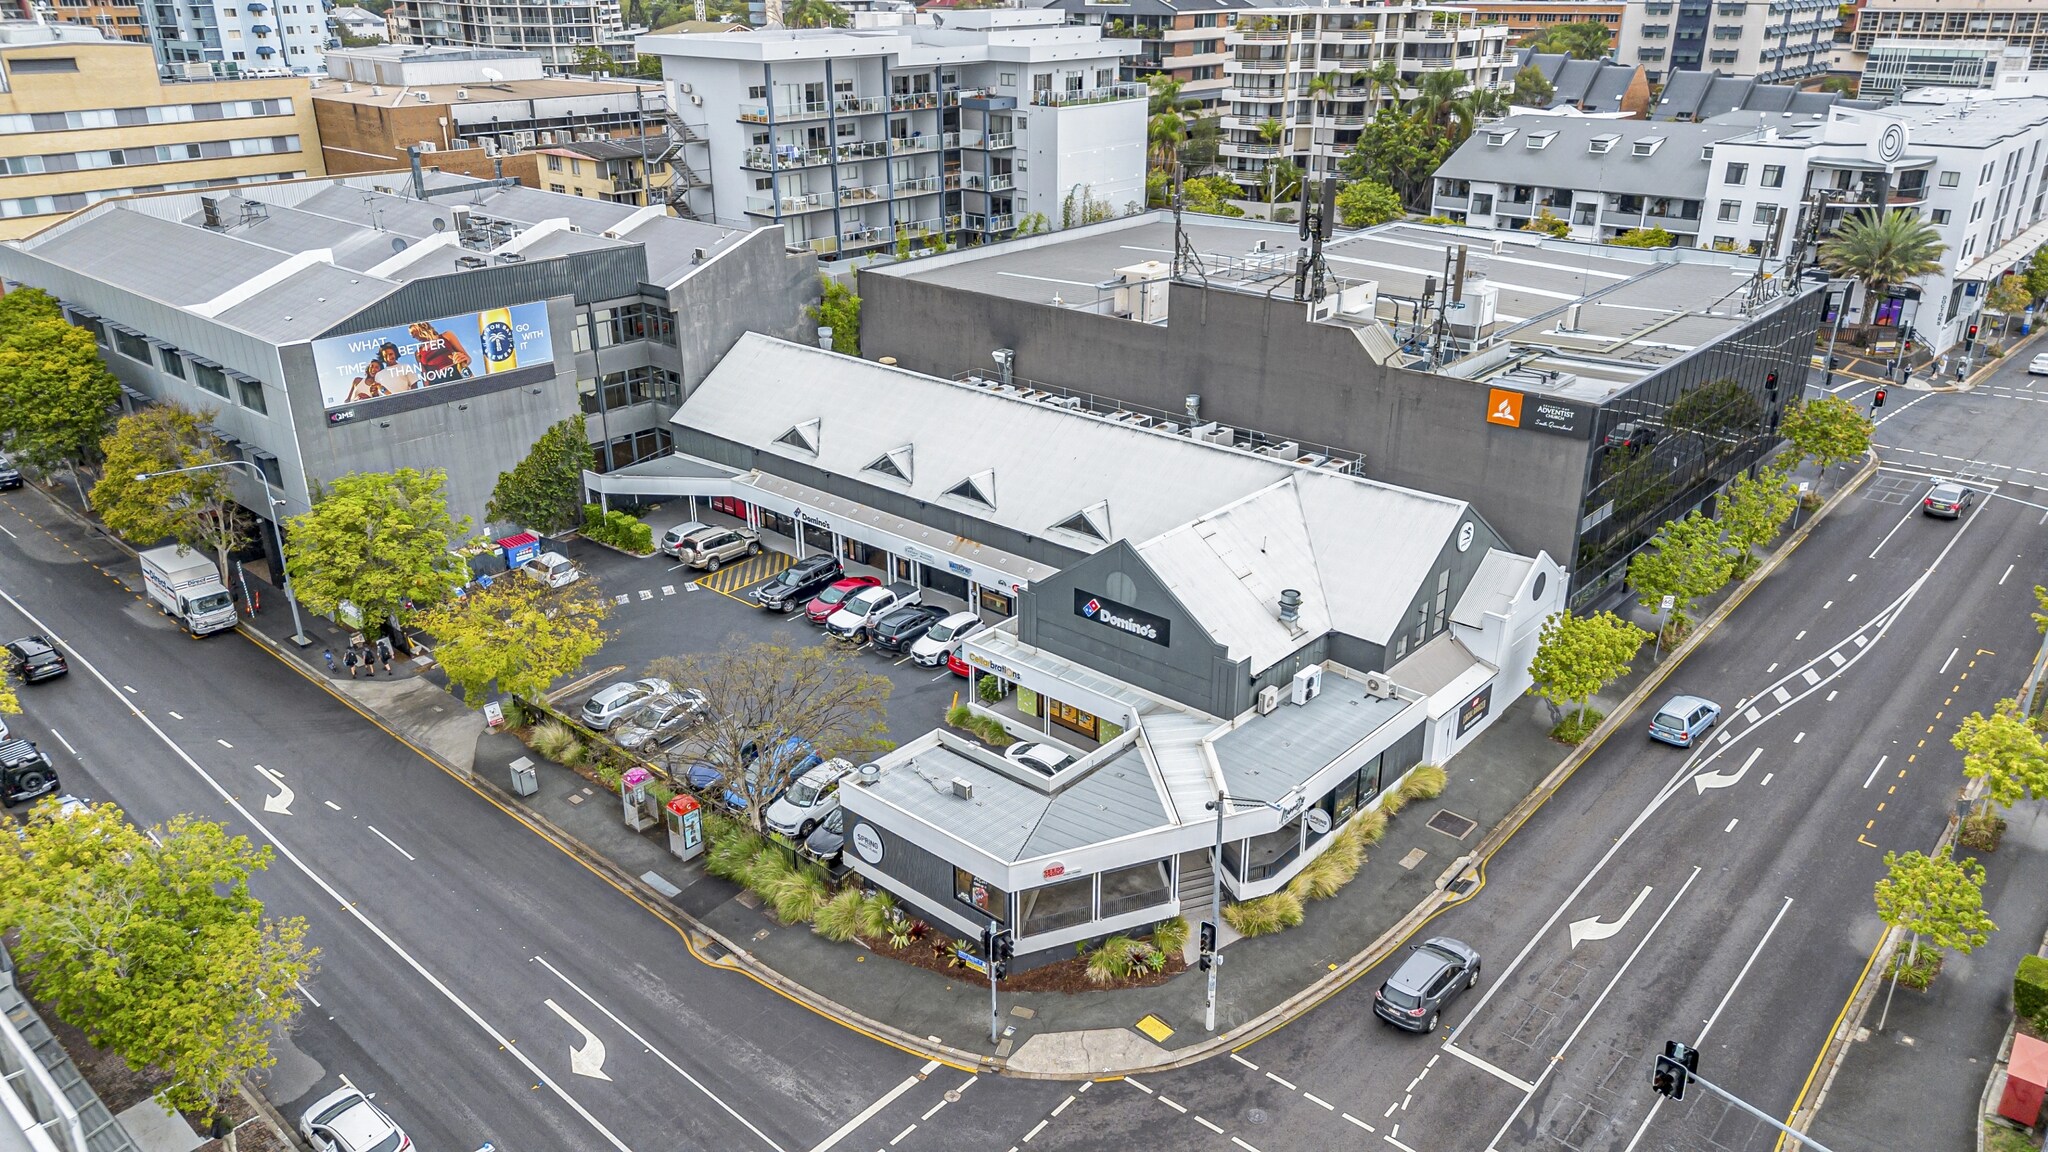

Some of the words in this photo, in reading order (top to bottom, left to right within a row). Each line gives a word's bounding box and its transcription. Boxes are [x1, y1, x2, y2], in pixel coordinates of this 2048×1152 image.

[516, 323, 530, 333] GO
[521, 330, 544, 341] WITH
[348, 336, 387, 353] WHAT
[398, 338, 446, 356] BETTER
[520, 341, 528, 350] IT
[336, 361, 367, 377] TIME
[387, 363, 423, 378] THAN
[417, 367, 454, 383] NOW?
[1537, 406, 1574, 418] ADVENTIST
[802, 512, 831, 529] Domino's
[1100, 609, 1157, 639] Domino's
[857, 833, 879, 850] SPRING
